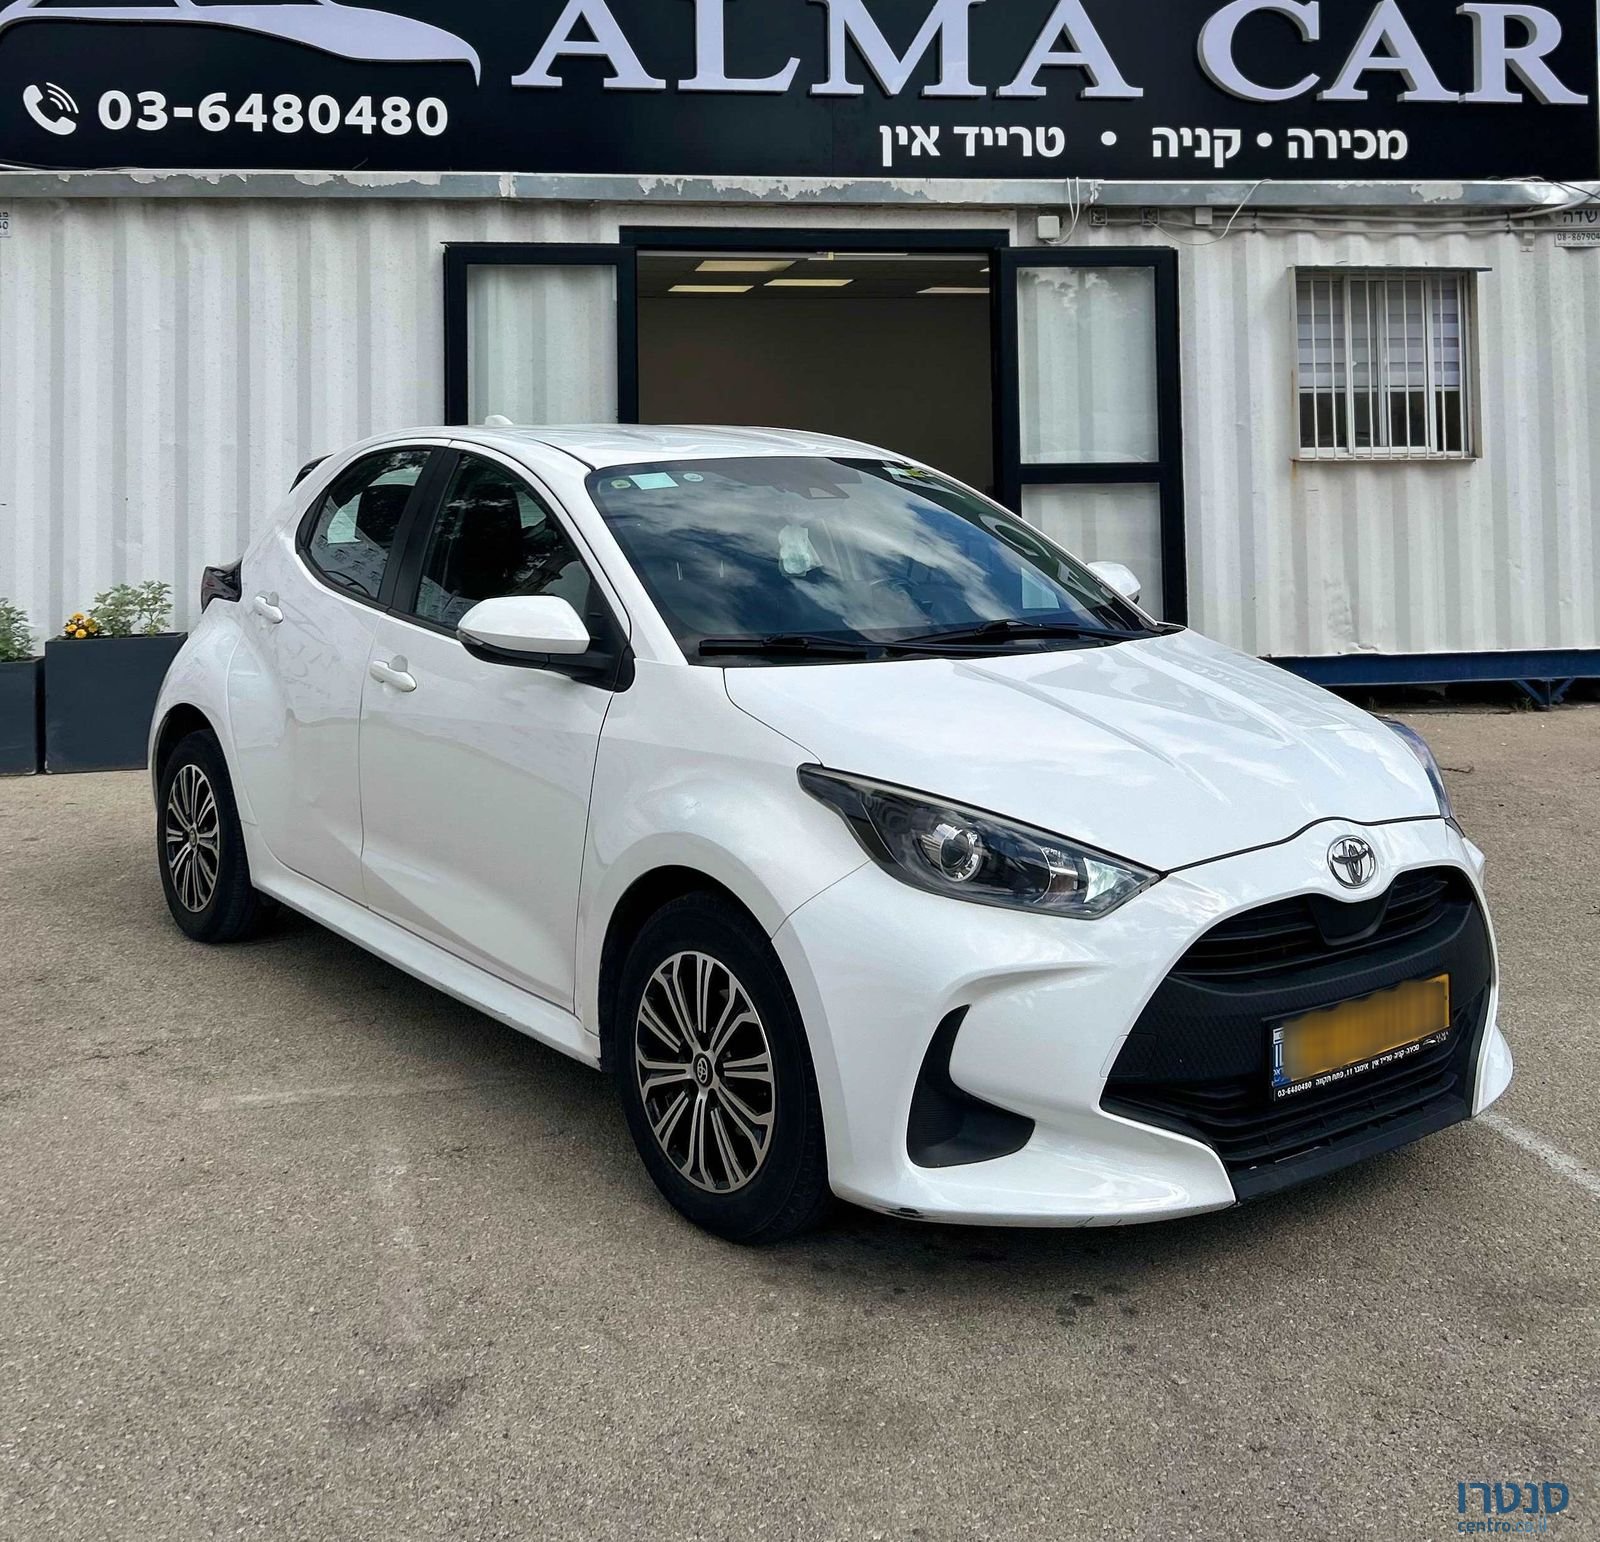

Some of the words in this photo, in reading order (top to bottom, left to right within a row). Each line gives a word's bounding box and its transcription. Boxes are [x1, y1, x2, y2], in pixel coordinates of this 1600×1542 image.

[511, 0, 1144, 100] ALMA
[1196, 0, 1589, 105] CAR
[97, 89, 449, 137] 03-6480480
[880, 125, 941, 167] אין
[953, 125, 1066, 158] טרייד
[1151, 126, 1241, 169] קניה
[1287, 128, 1408, 161] מכירה
